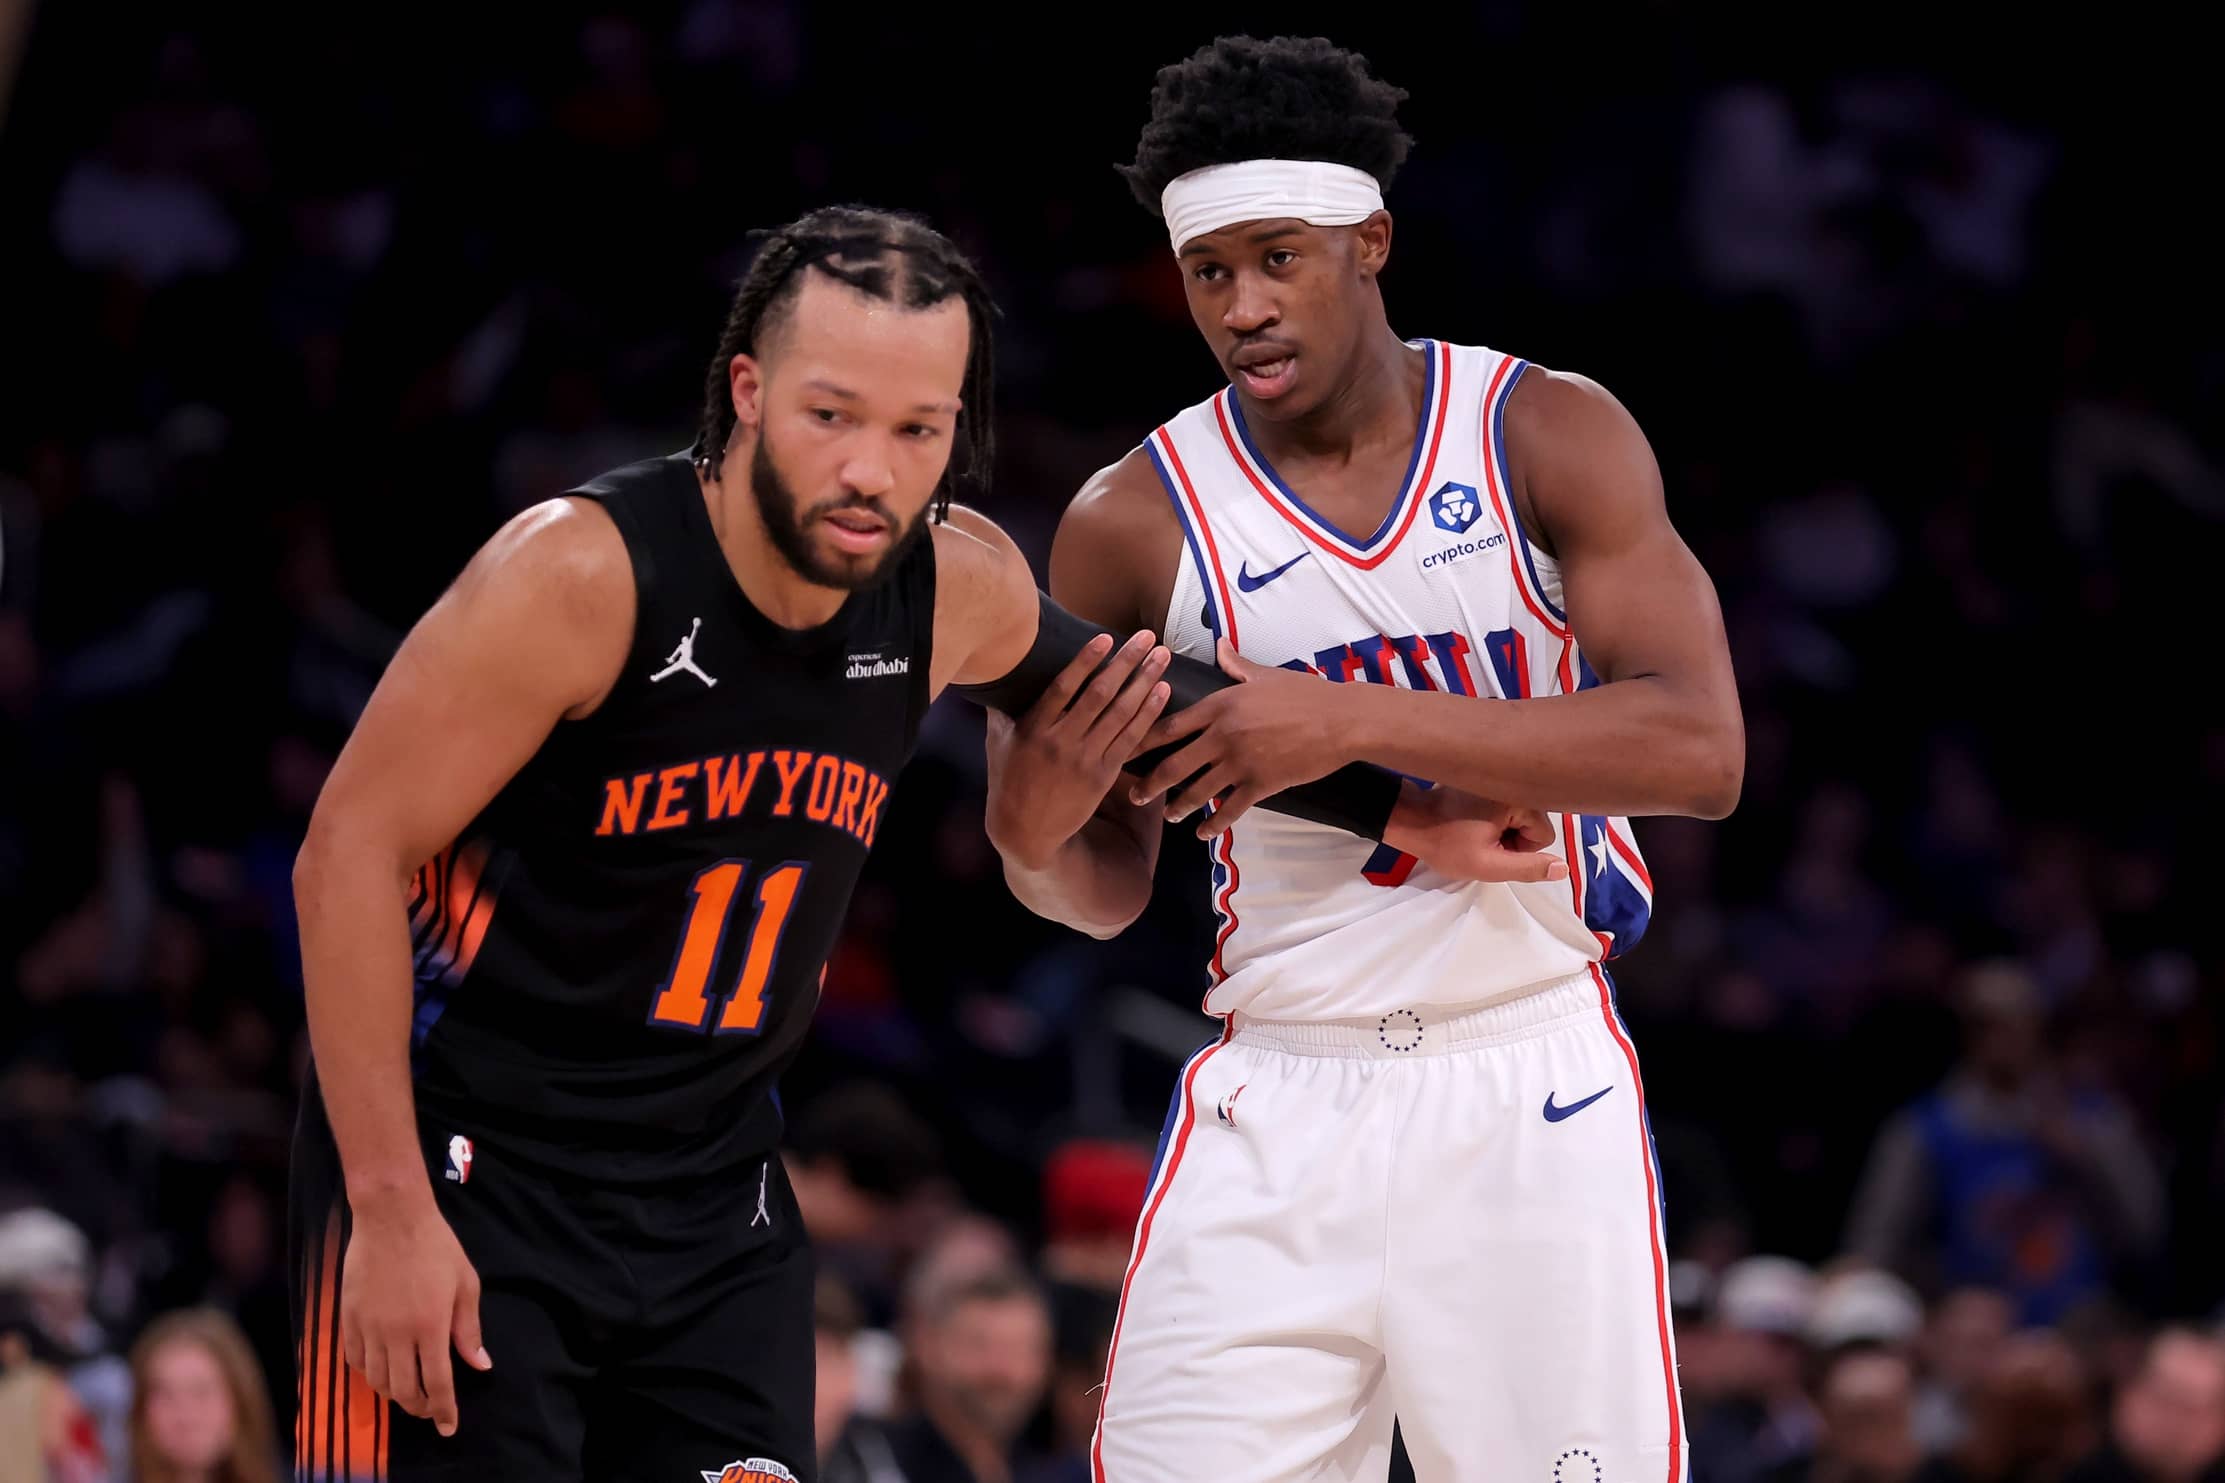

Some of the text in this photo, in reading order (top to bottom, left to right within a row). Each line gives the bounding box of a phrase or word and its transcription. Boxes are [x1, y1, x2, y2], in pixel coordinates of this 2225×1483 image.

[1422, 533, 1507, 568] crypto.com
[594, 750, 889, 851] NEW YORK
[646, 857, 812, 1037] 11
